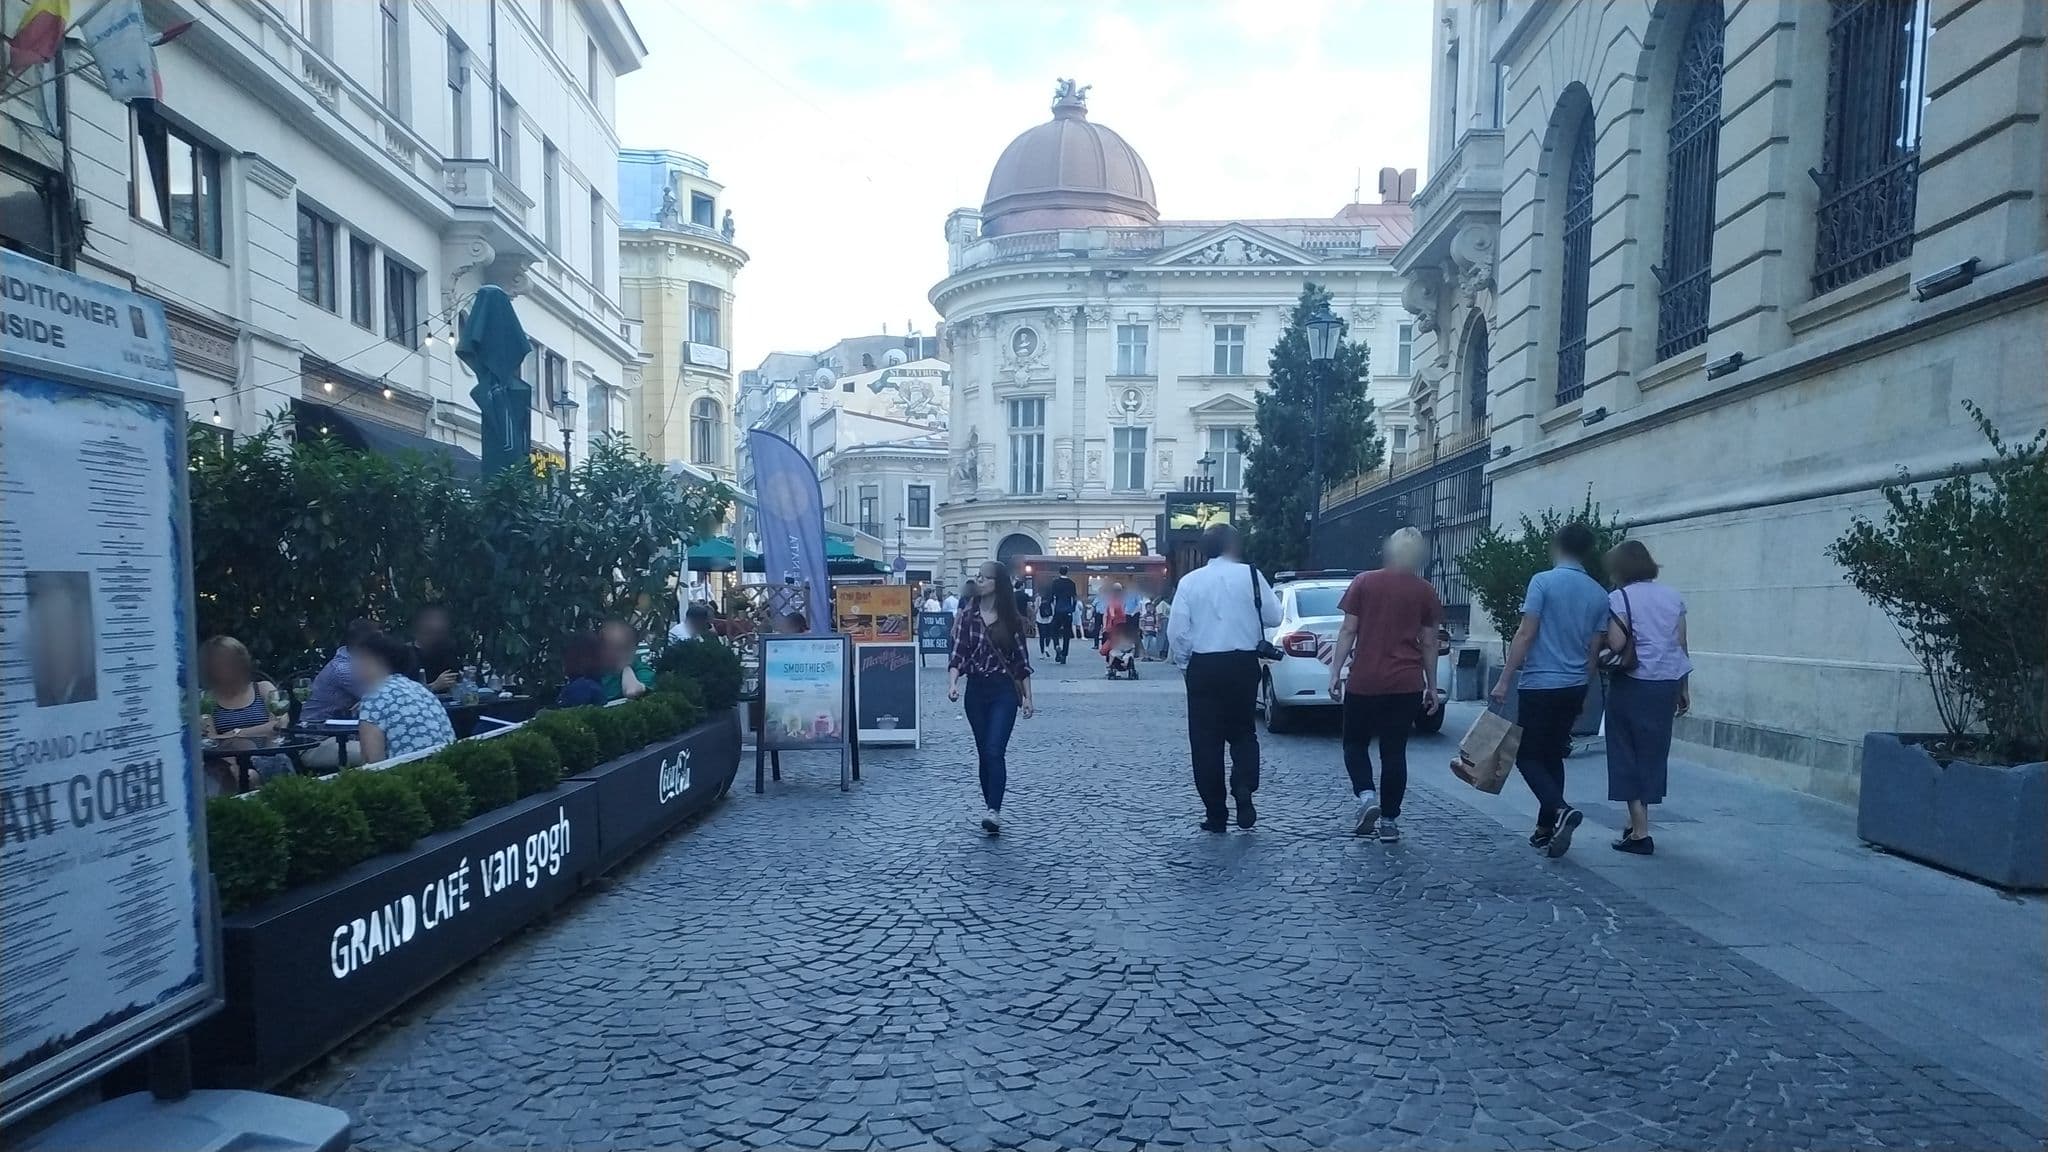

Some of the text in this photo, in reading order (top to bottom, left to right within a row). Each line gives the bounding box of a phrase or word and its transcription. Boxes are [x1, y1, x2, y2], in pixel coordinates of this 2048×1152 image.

[783, 662, 826, 674] SMOOTHIES
[11, 735, 77, 767] GRAND
[68, 758, 165, 829] GOGH
[331, 806, 570, 979] GRAND CAFÉ van gogh
